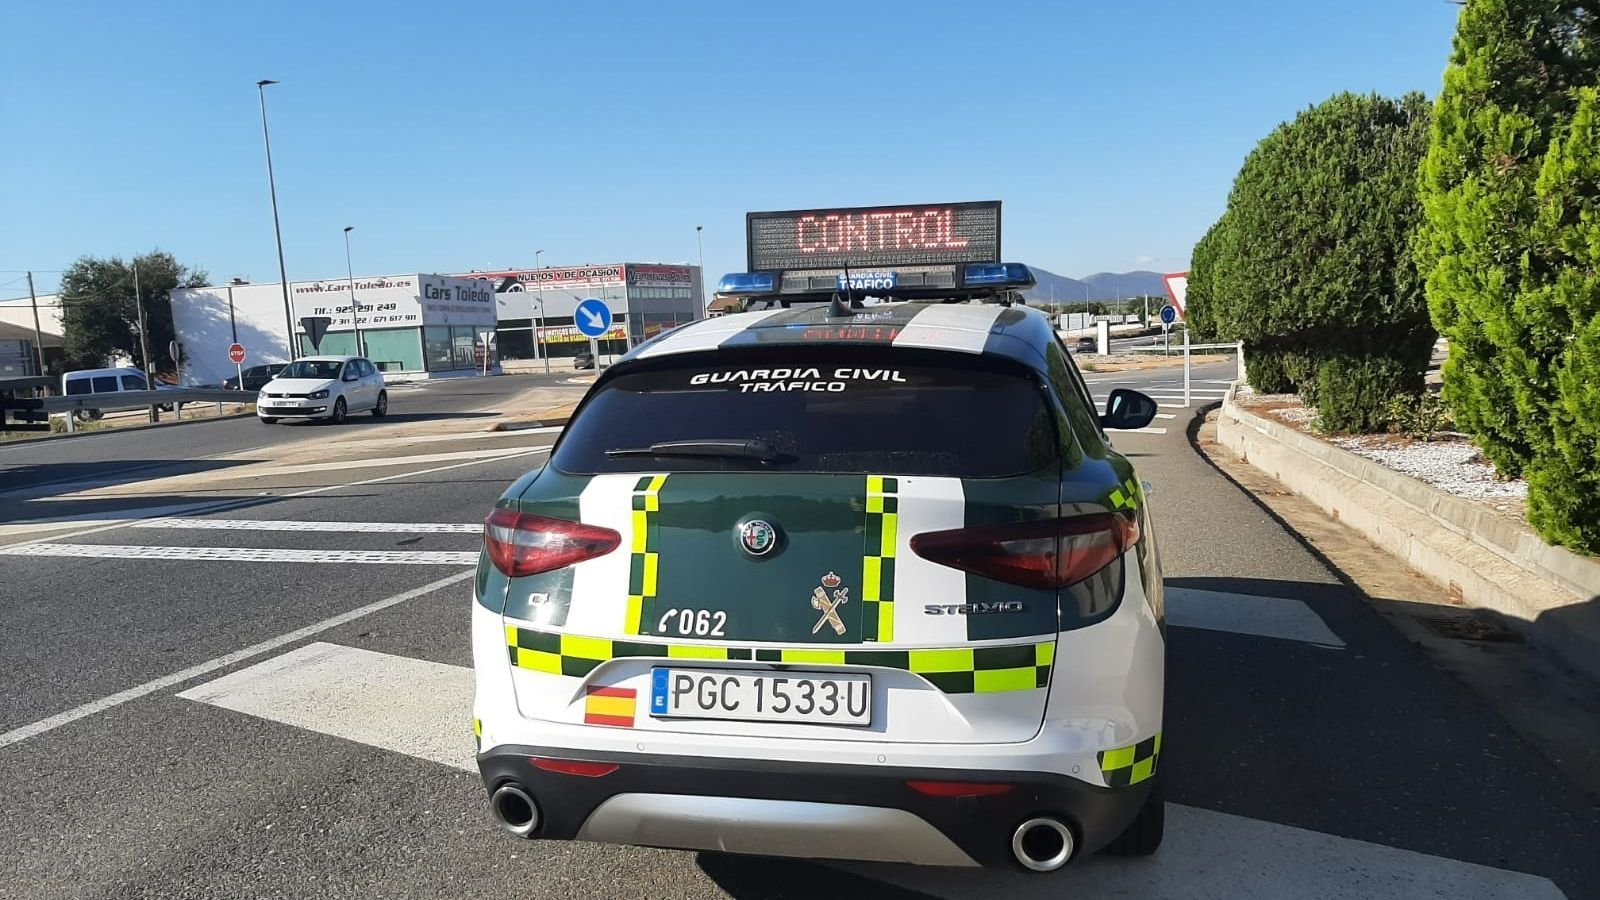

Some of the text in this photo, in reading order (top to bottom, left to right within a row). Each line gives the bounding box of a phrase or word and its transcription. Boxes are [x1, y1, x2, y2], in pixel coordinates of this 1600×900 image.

[797, 209, 969, 252] CONTROL
[564, 271, 578, 279] DE
[425, 283, 490, 302] Cars Toledo
[335, 306, 353, 314] 925
[357, 304, 374, 313] 291
[377, 303, 397, 311] 249
[690, 368, 907, 385] GUARDIA CIVIL
[739, 380, 846, 393] TRÁFICO
[924, 601, 1023, 615] STELVIO
[679, 608, 727, 636] 062
[673, 674, 741, 711] PGC
[655, 695, 664, 706] E
